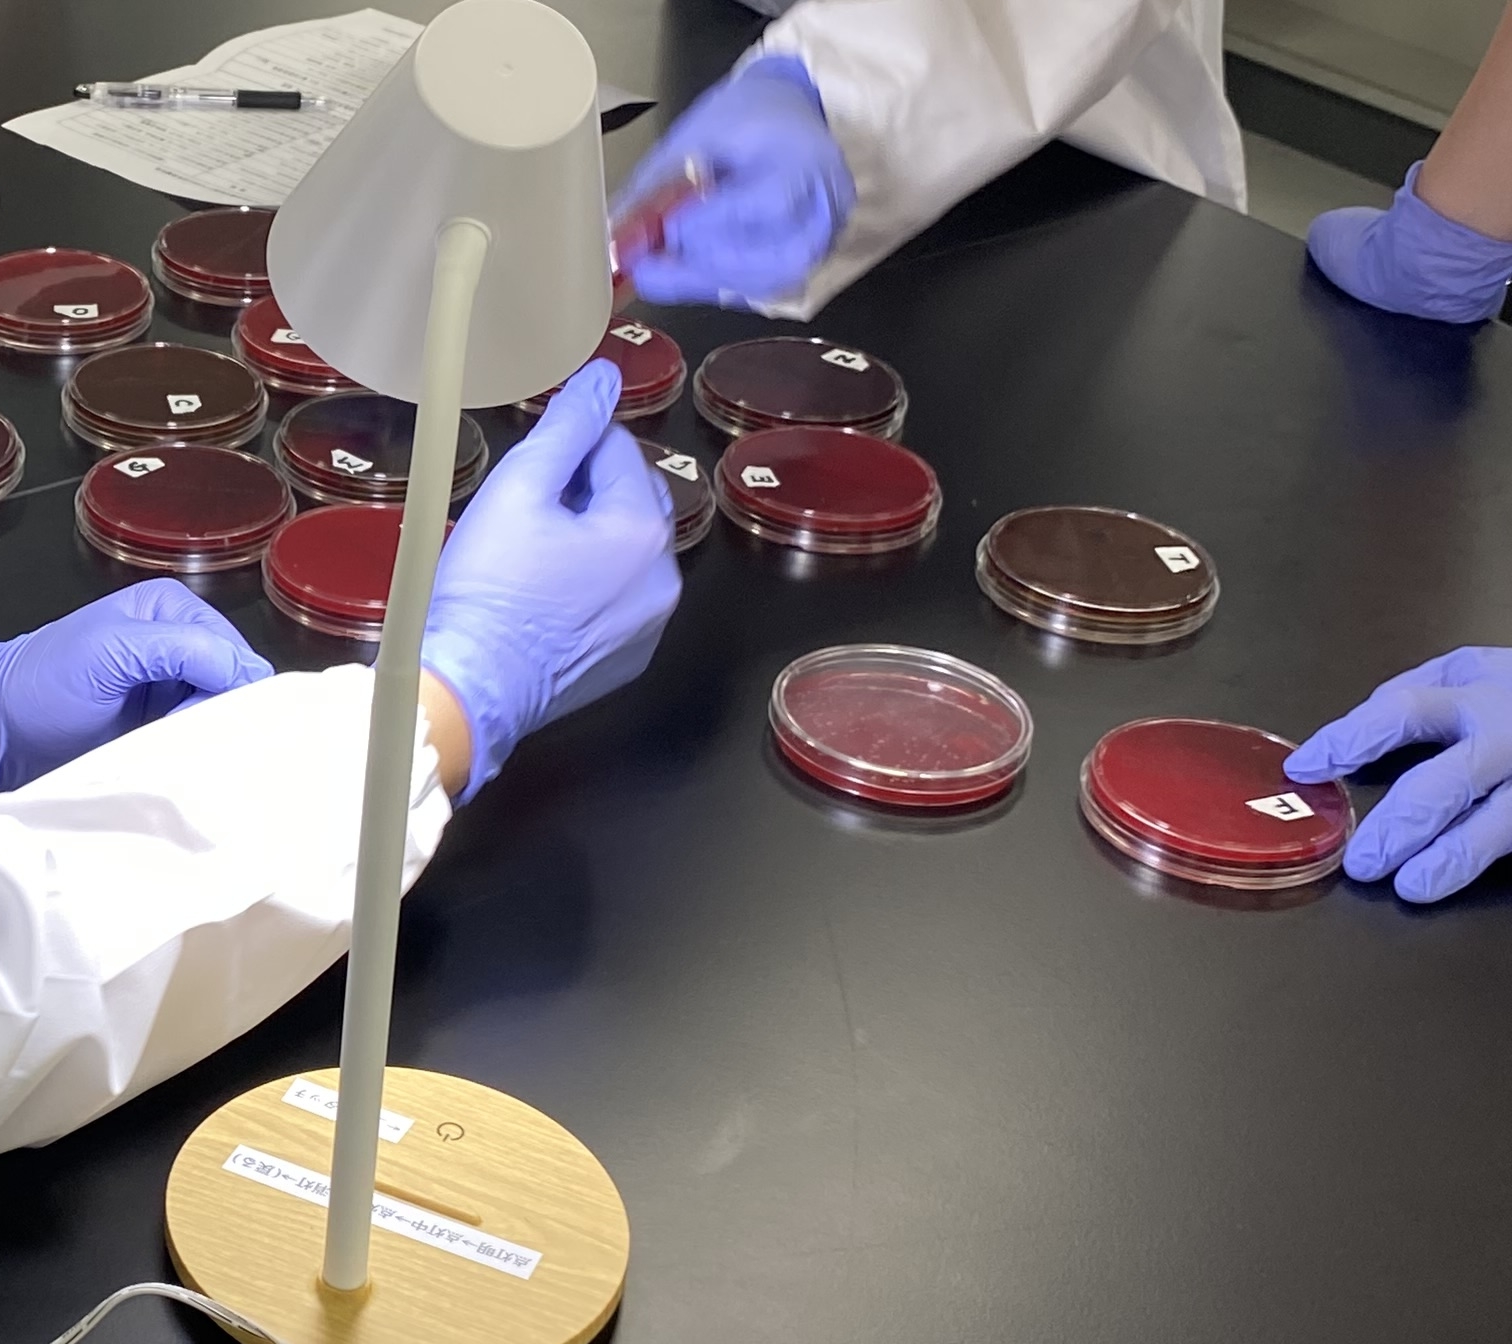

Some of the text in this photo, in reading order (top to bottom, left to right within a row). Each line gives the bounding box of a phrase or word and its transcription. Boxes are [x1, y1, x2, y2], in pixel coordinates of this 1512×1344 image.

[624, 330, 644, 339] H
[128, 461, 151, 472] G
[1168, 553, 1190, 564] T
[1274, 797, 1299, 815] F
